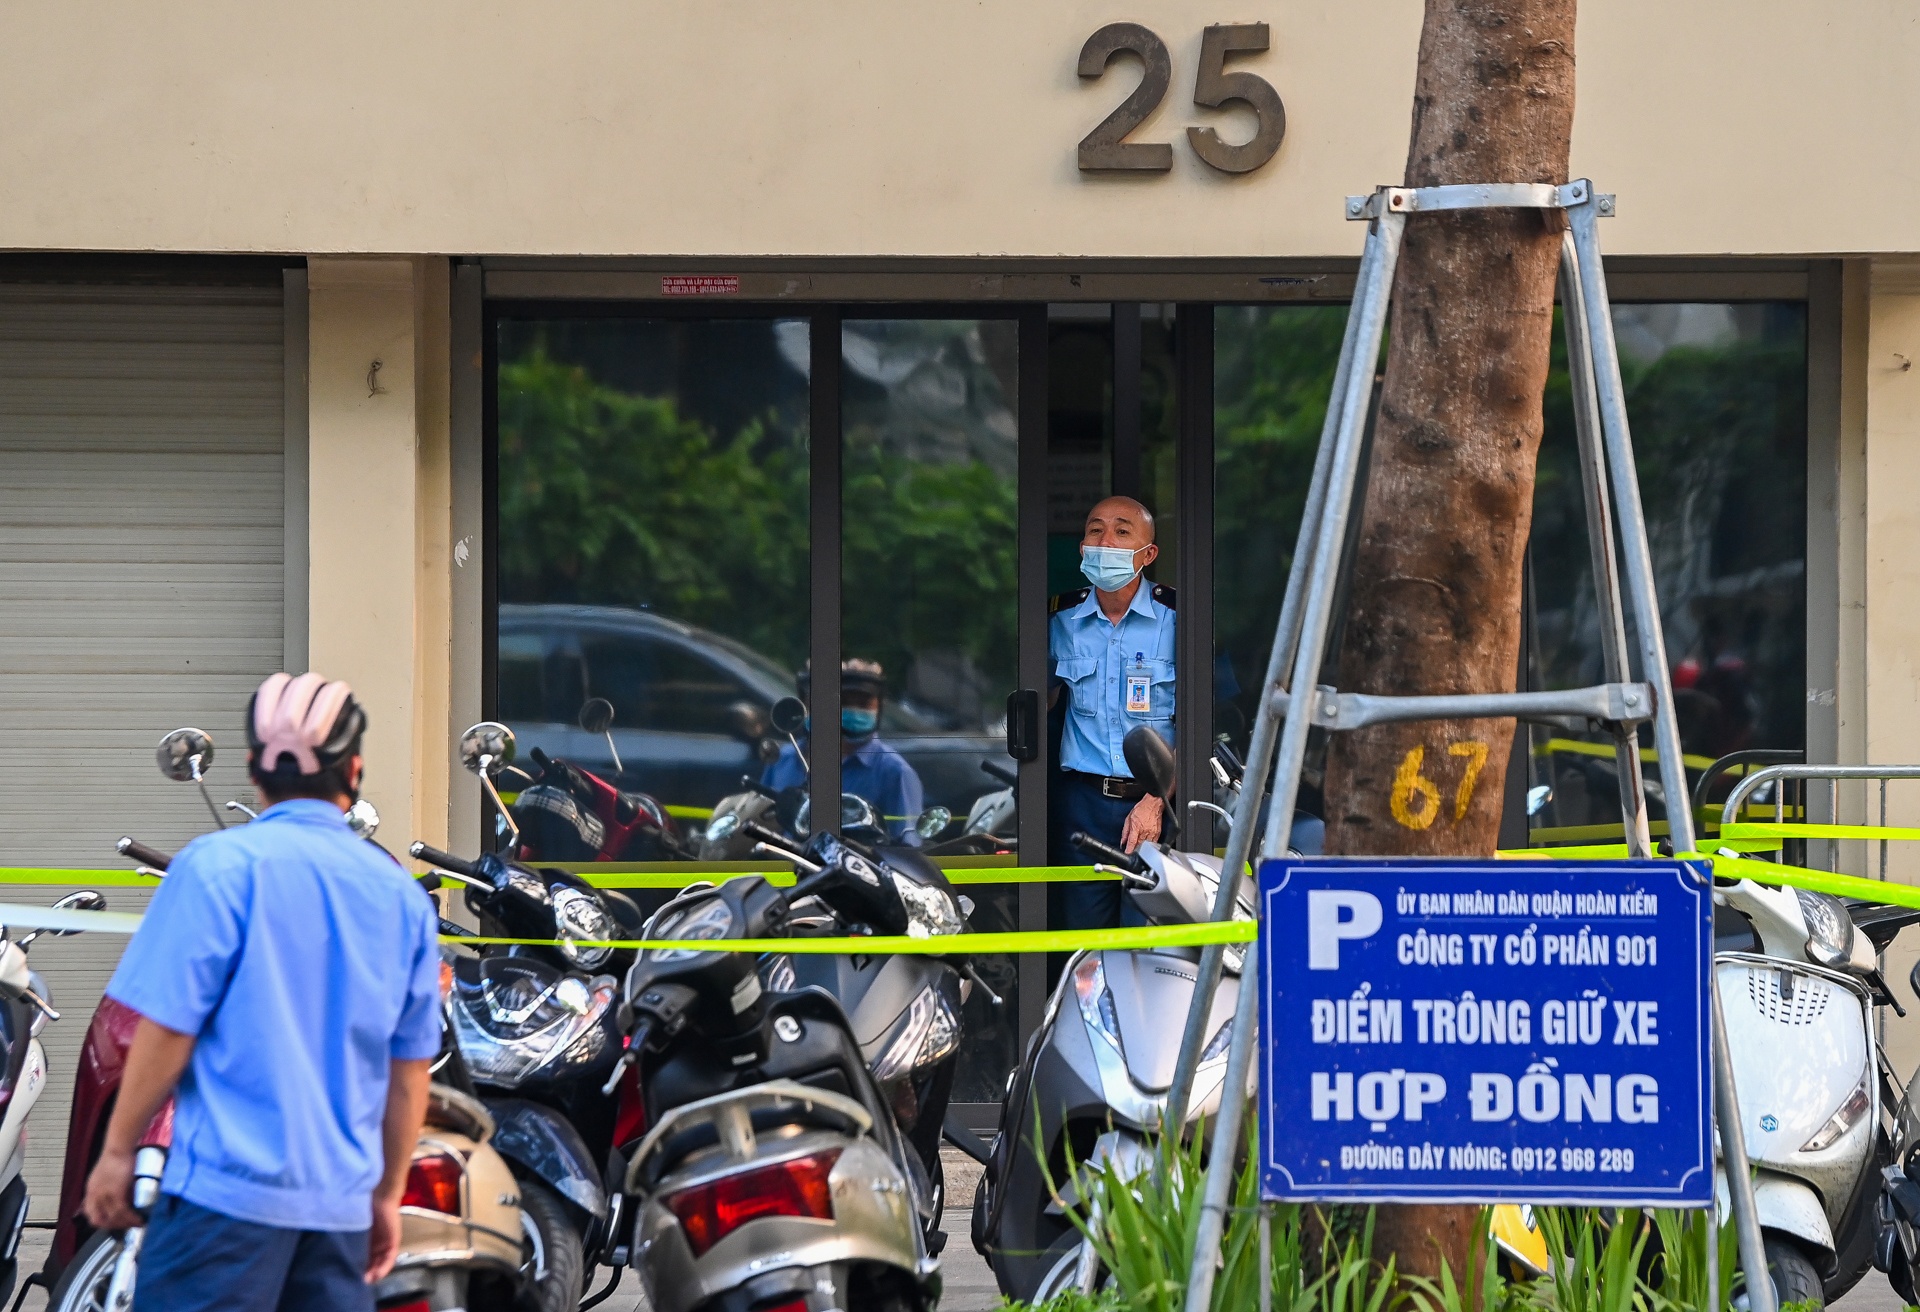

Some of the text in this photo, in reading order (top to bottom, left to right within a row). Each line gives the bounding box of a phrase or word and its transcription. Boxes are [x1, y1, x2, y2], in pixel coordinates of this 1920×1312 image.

[1077, 21, 1287, 174] 25
[1390, 741, 1489, 831] 67
[1308, 889, 1384, 971] P
[1396, 886, 1658, 920] ỦY BAN NHÂN DÂN QUẬN HOÀN KIẾM
[1397, 923, 1657, 966] CÔNG TY CỔ PHẦN 901
[1311, 981, 1659, 1046] ĐIỂM TRÔNG GIỮ XE
[1311, 1057, 1659, 1132] HỢP ĐỒNG
[1340, 1140, 1635, 1173] ĐƯỜNG DÂY NÓNG: 0912 968 289
